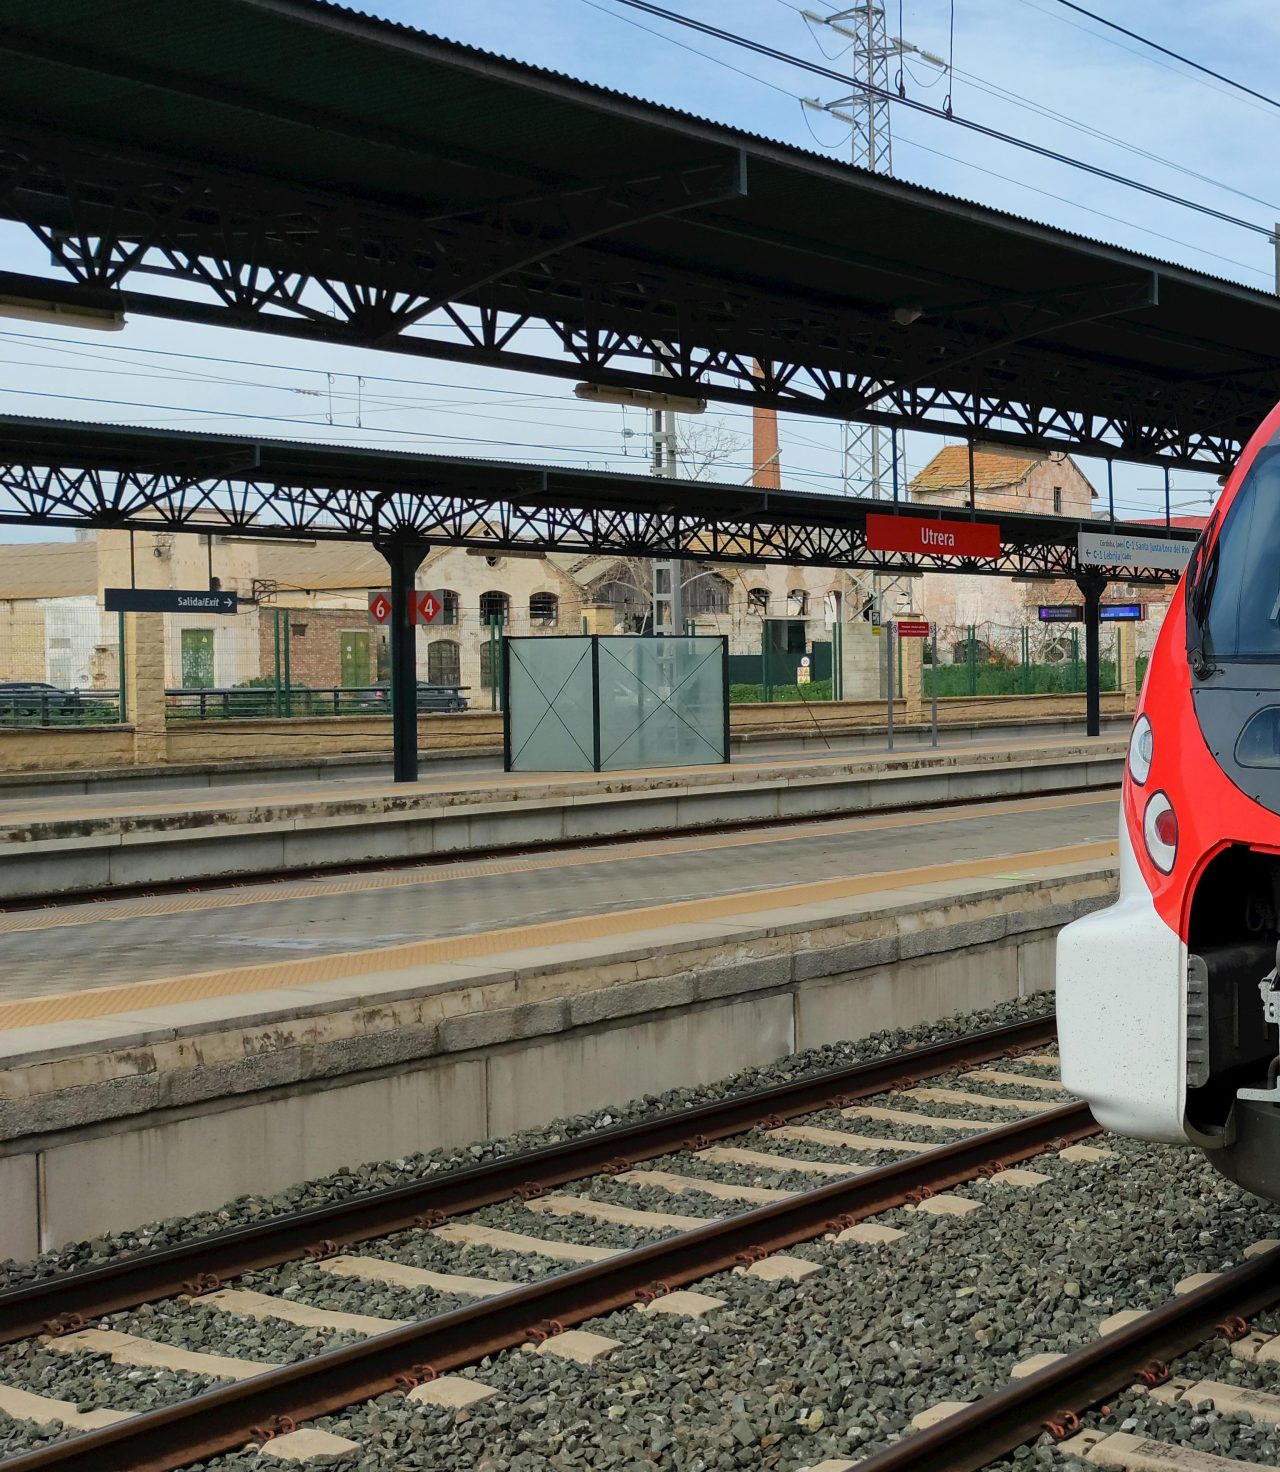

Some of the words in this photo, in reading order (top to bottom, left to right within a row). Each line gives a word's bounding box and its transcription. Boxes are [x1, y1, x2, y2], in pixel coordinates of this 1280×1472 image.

[920, 527, 955, 546] Utrera
[1135, 541, 1149, 551] Santa
[1173, 544, 1181, 554] del
[1093, 550, 1103, 560] C-1
[1103, 550, 1120, 562] Lebrija
[177, 596, 220, 607] Salida/Exit
[376, 599, 385, 618] 6
[424, 598, 434, 616] 4
